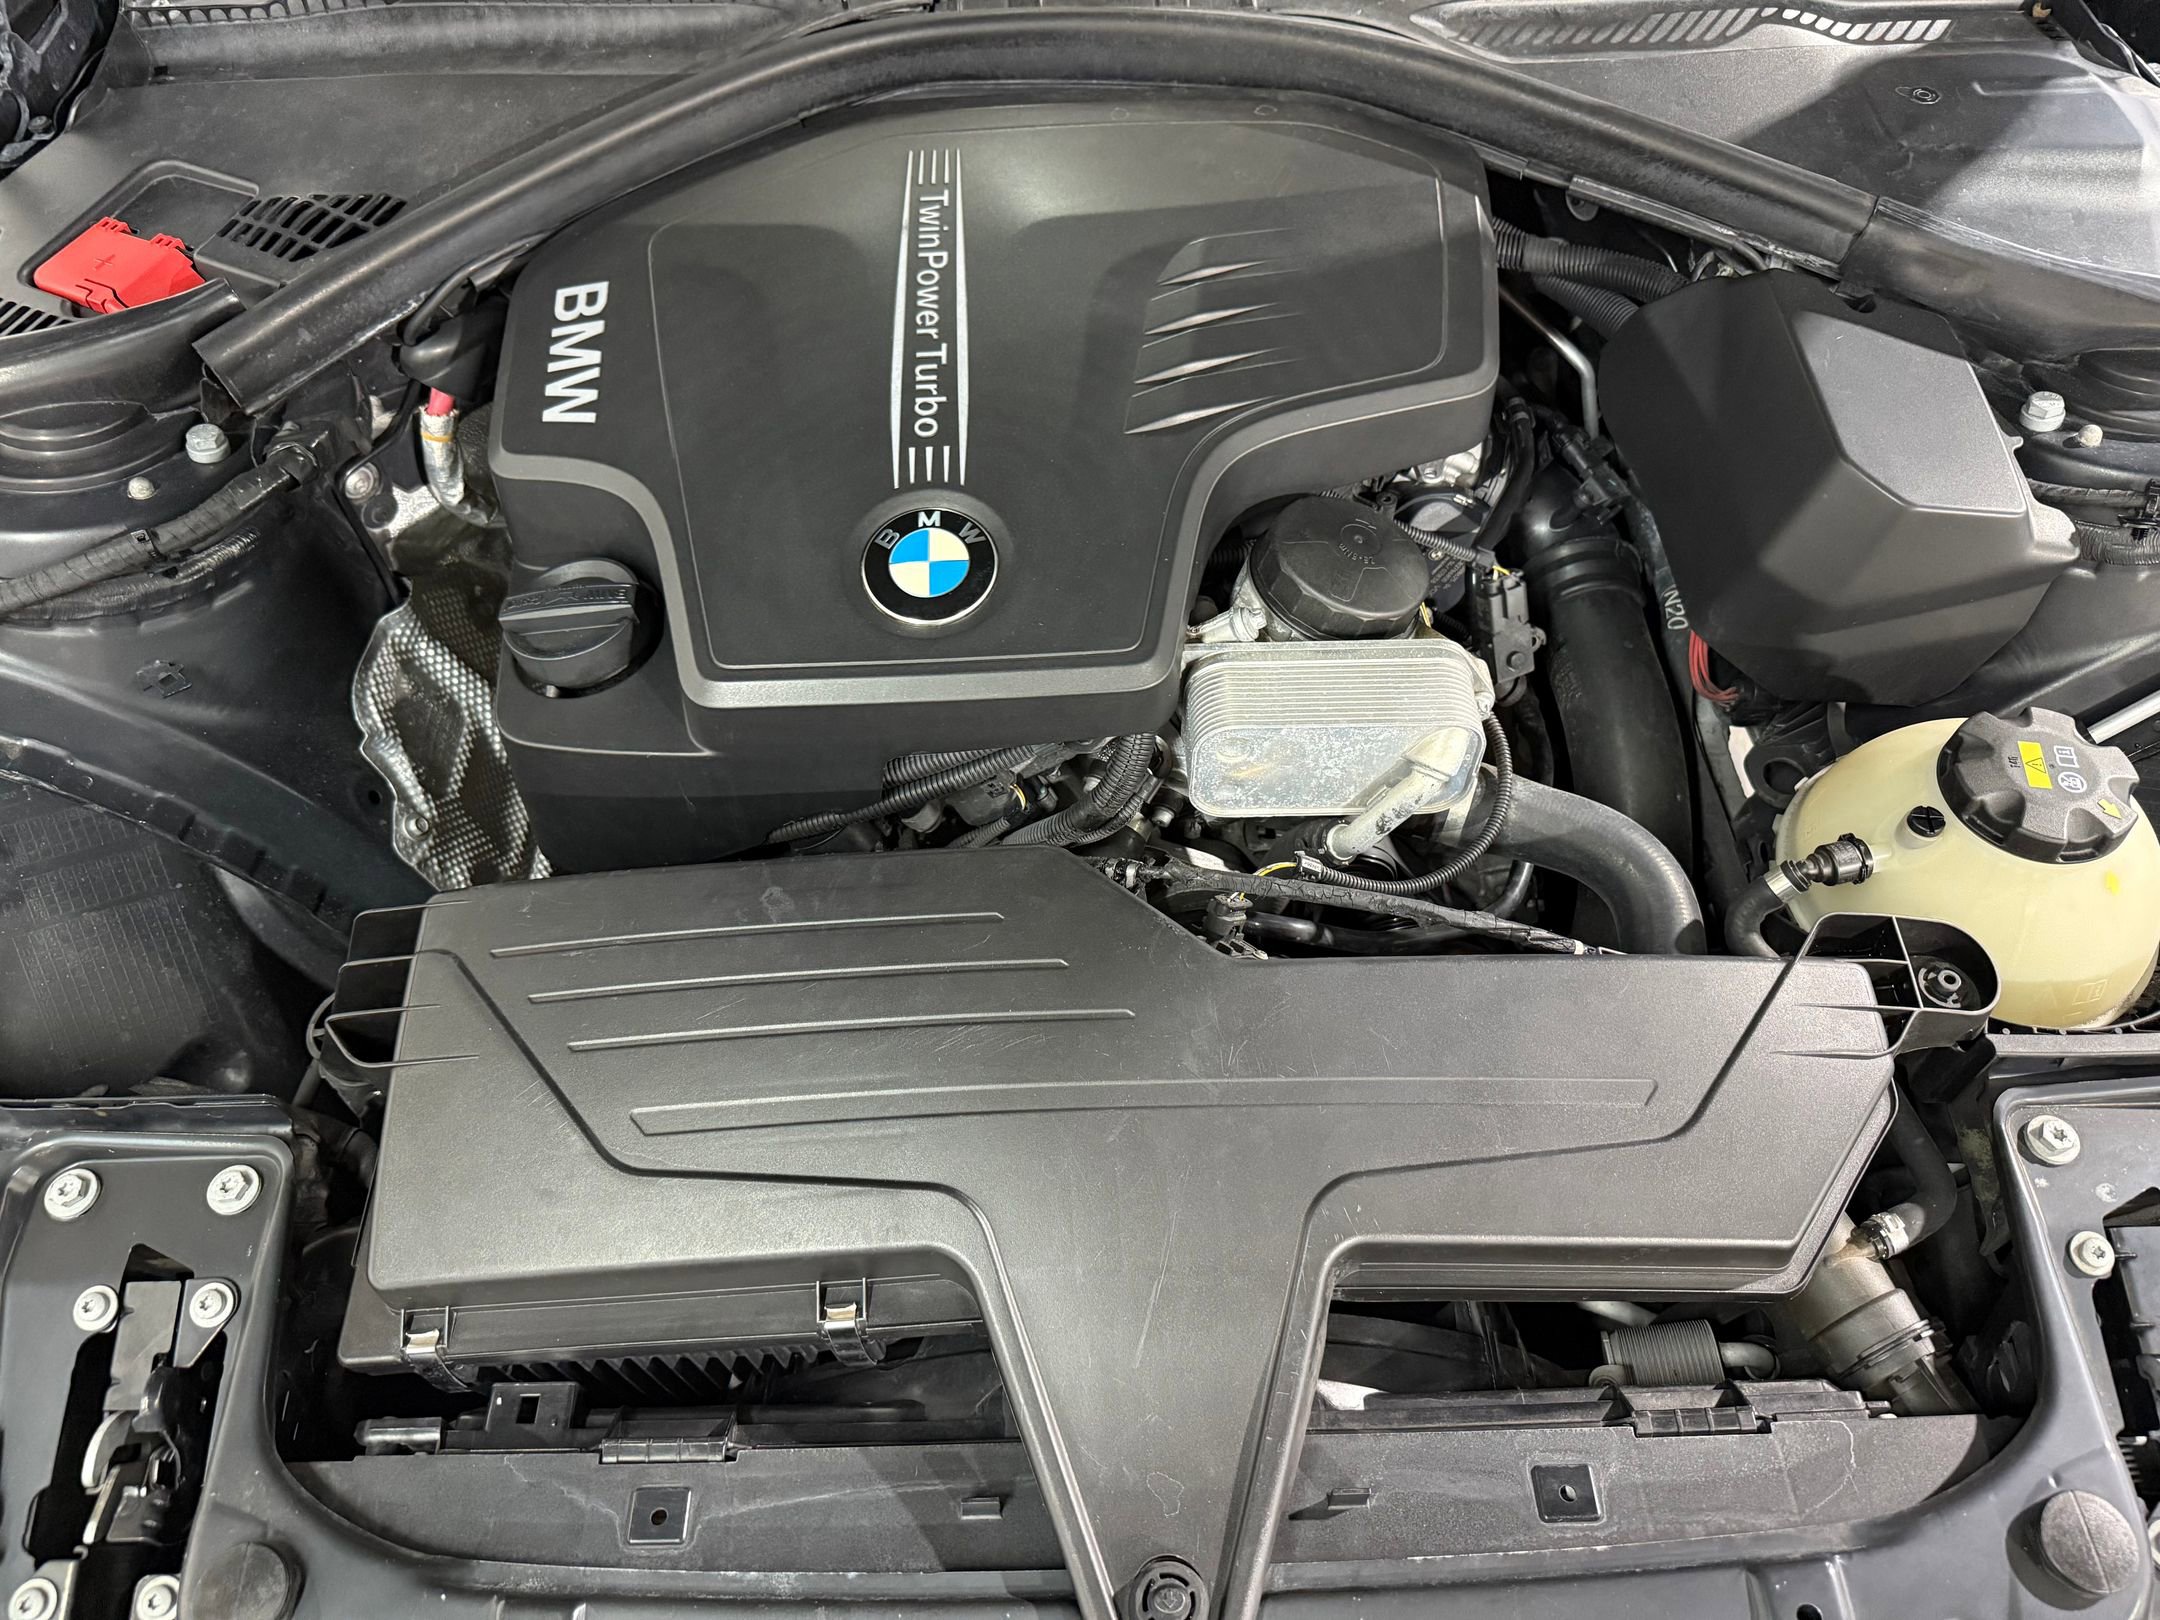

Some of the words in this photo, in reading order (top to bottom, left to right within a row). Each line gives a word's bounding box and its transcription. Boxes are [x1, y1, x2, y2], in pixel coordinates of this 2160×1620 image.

[915, 189, 949, 339] TwinPower
[542, 281, 609, 423] BMW
[913, 342, 948, 438] Turbo
[874, 510, 987, 550] BMW
[1663, 589, 1689, 630] N20
